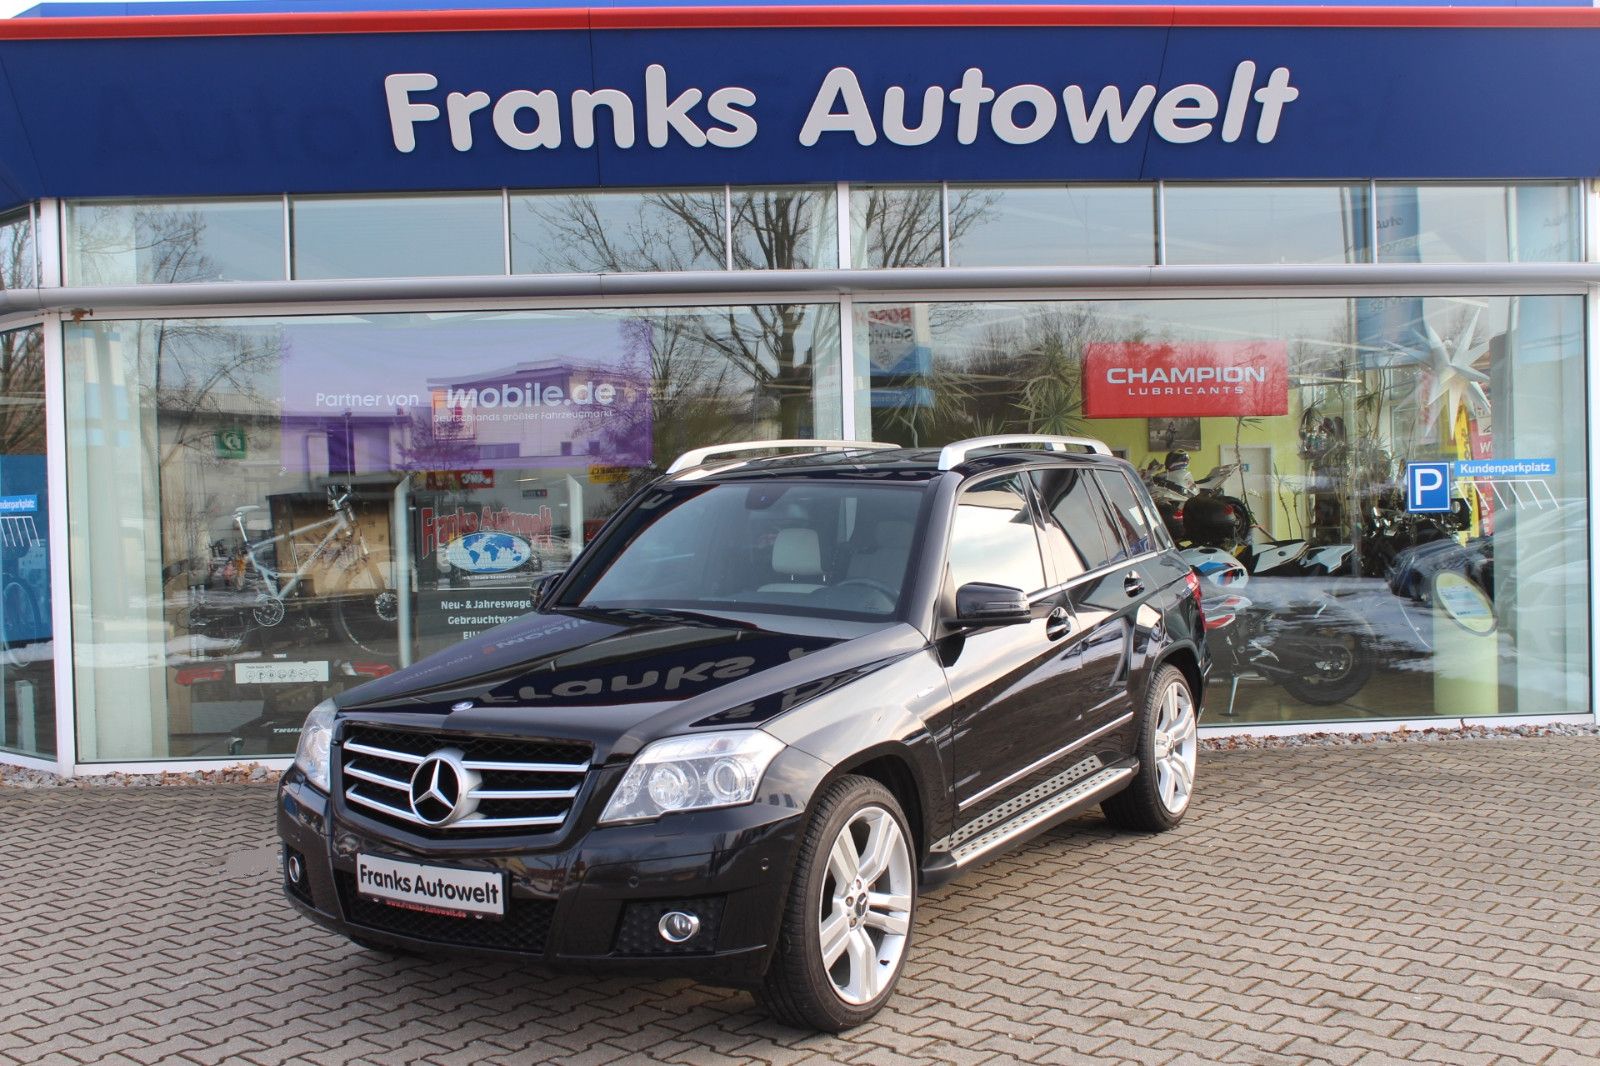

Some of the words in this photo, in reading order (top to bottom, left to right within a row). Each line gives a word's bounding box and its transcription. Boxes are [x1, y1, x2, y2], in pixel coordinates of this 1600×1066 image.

[384, 64, 757, 153] Franks
[799, 60, 1299, 147] Autowelt
[1106, 366, 1265, 385] CHAMPION
[315, 392, 381, 407] Partner
[387, 393, 419, 407] von
[446, 381, 616, 409] mobile.de
[1128, 386, 1245, 396] LUBRICANTS
[1460, 463, 1551, 475] Kundenparkplatz
[1414, 468, 1443, 506] P
[441, 600, 464, 610] Neu-
[465, 601, 473, 609] &
[360, 863, 412, 893] Franks
[414, 875, 499, 905] Autowelt
